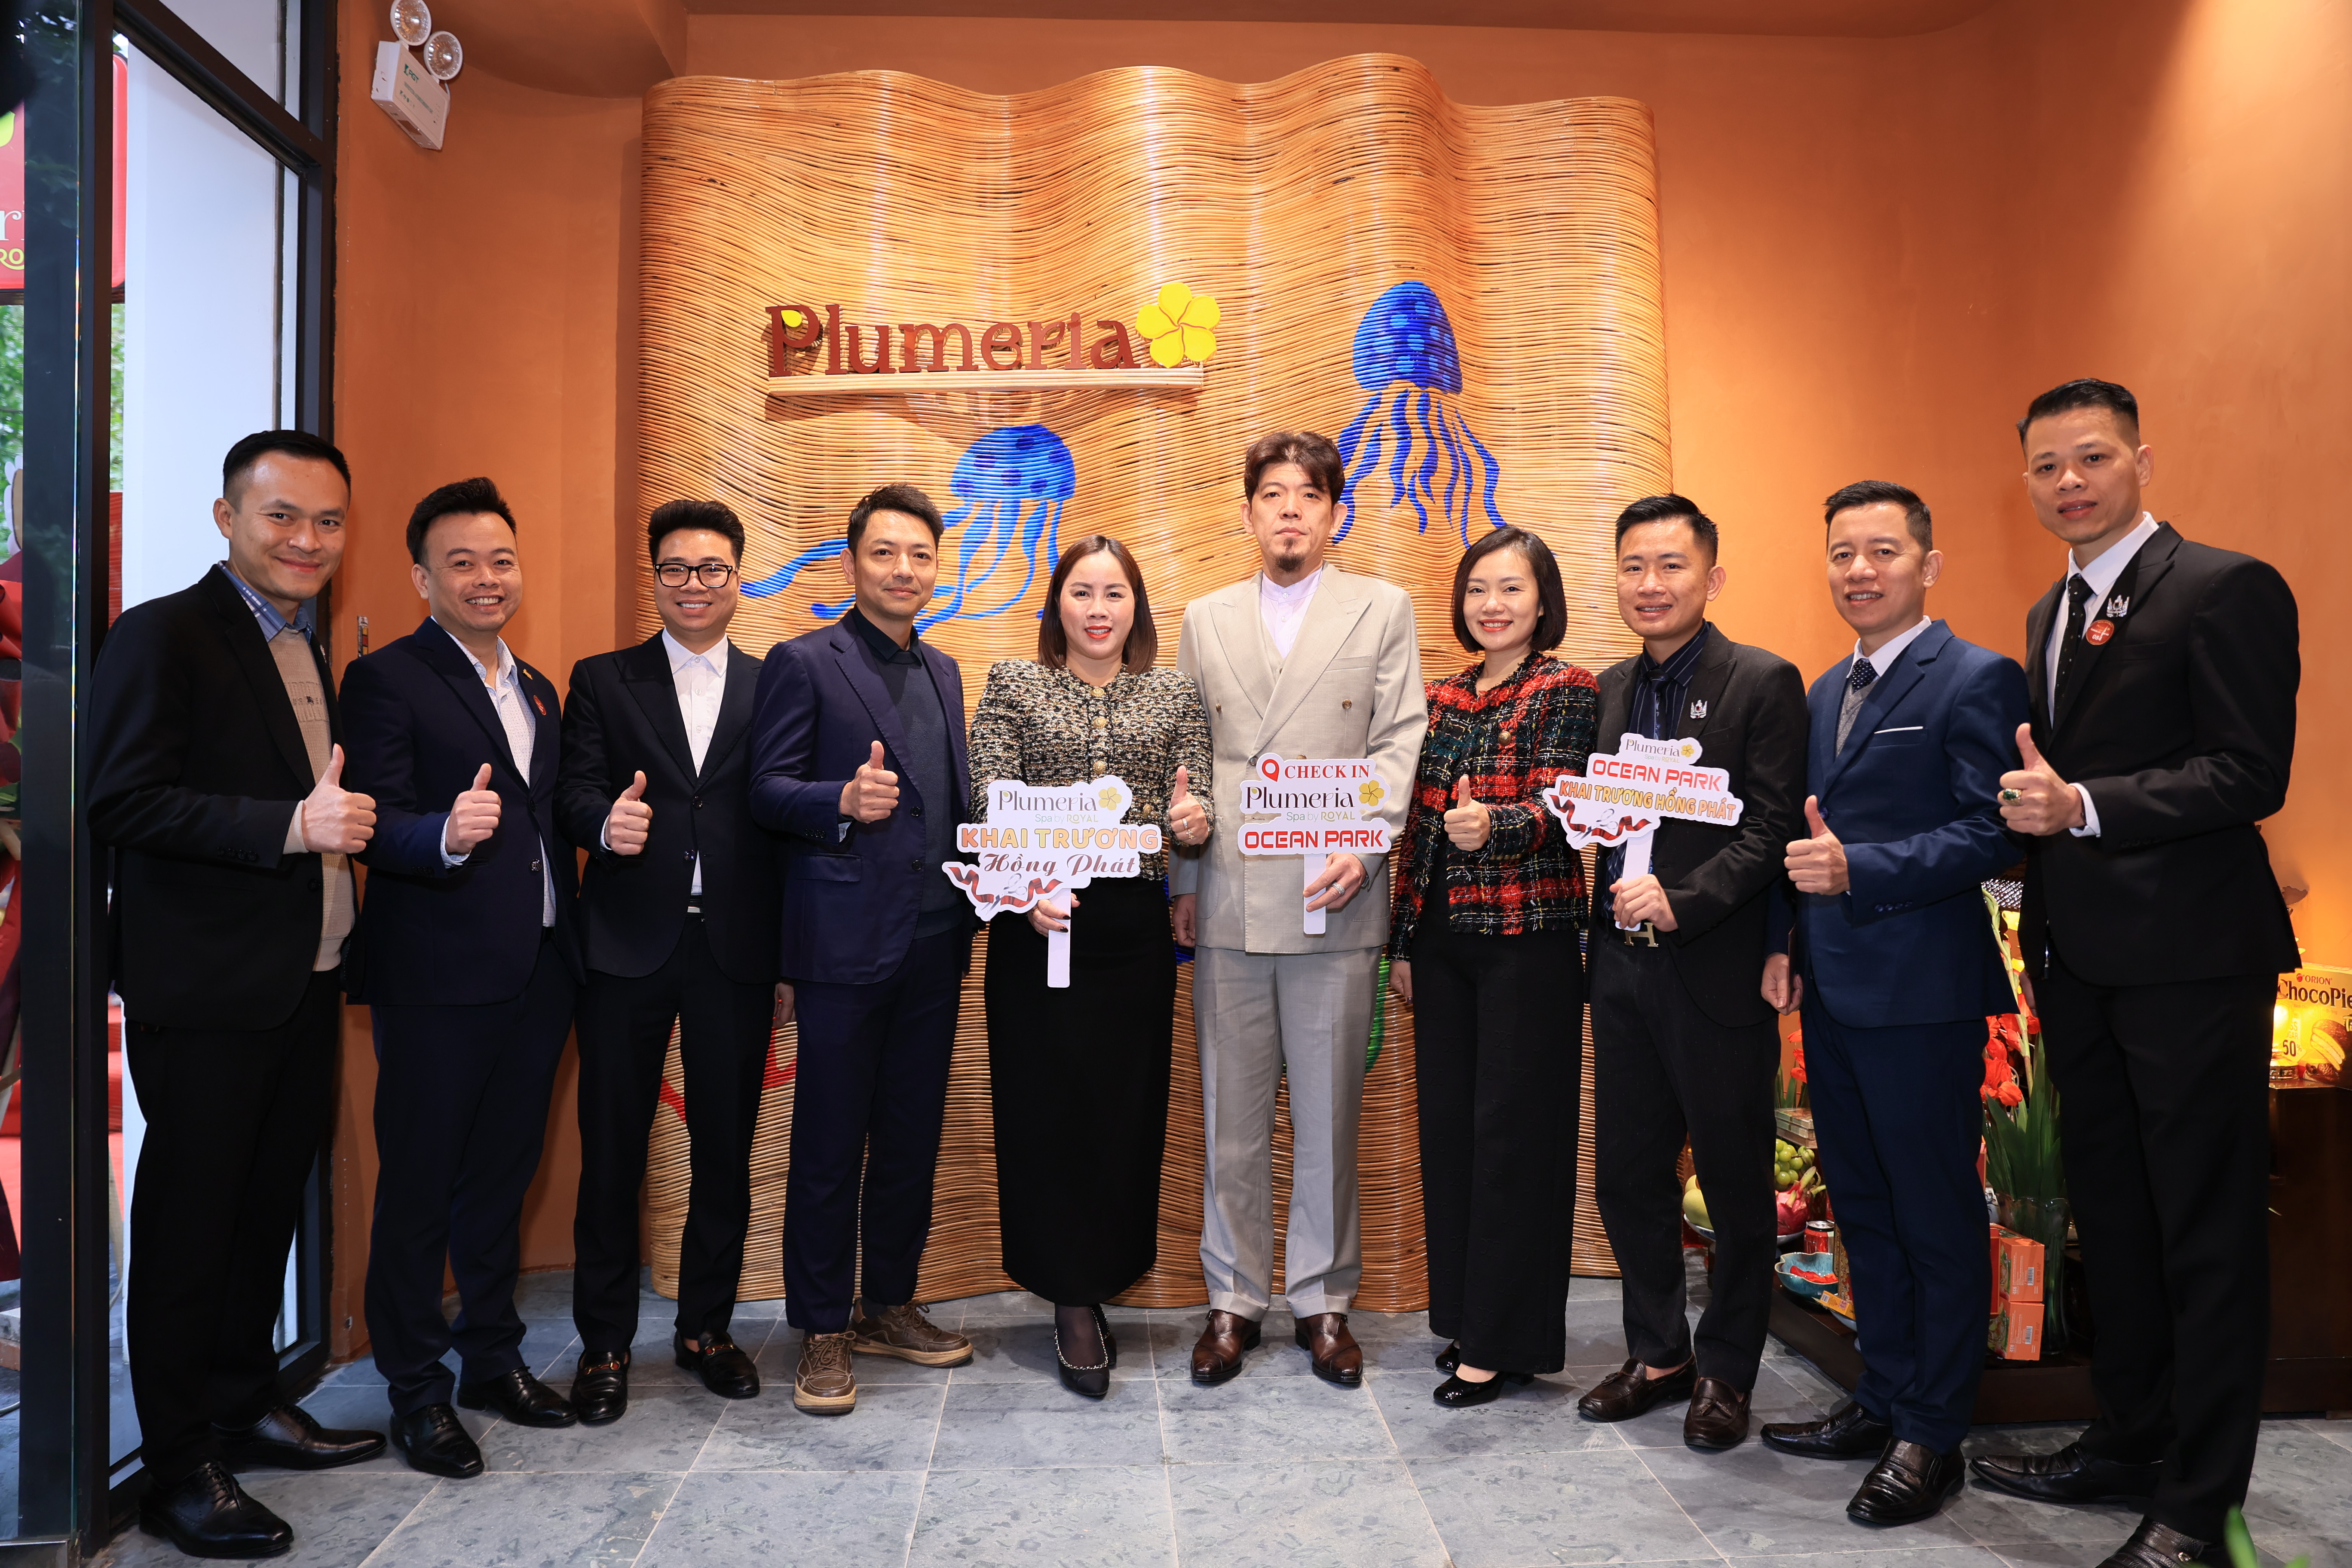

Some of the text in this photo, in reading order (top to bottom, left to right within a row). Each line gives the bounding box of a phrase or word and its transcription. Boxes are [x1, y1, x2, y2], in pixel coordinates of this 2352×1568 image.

[766, 303, 1141, 377] Plumeria
[1625, 739, 1680, 757] Plumeria
[1285, 765, 1370, 779] CHECK IN
[1592, 760, 1722, 792] OCEAN PARK
[998, 790, 1098, 811] Plumeria
[1245, 786, 1356, 808] Plumeria
[1559, 781, 1736, 821] KHAI TRƯƠNG HỒNG PHÁT
[1035, 814, 1098, 824] Spa by ROYAL
[1286, 811, 1356, 822] Spa by ROYAL
[961, 827, 1158, 849] KHAI TRƯƠNG
[1245, 830, 1384, 849] OCEAN PARK
[983, 853, 1136, 876] Hồng Phát
[2305, 975, 2331, 985] ORION
